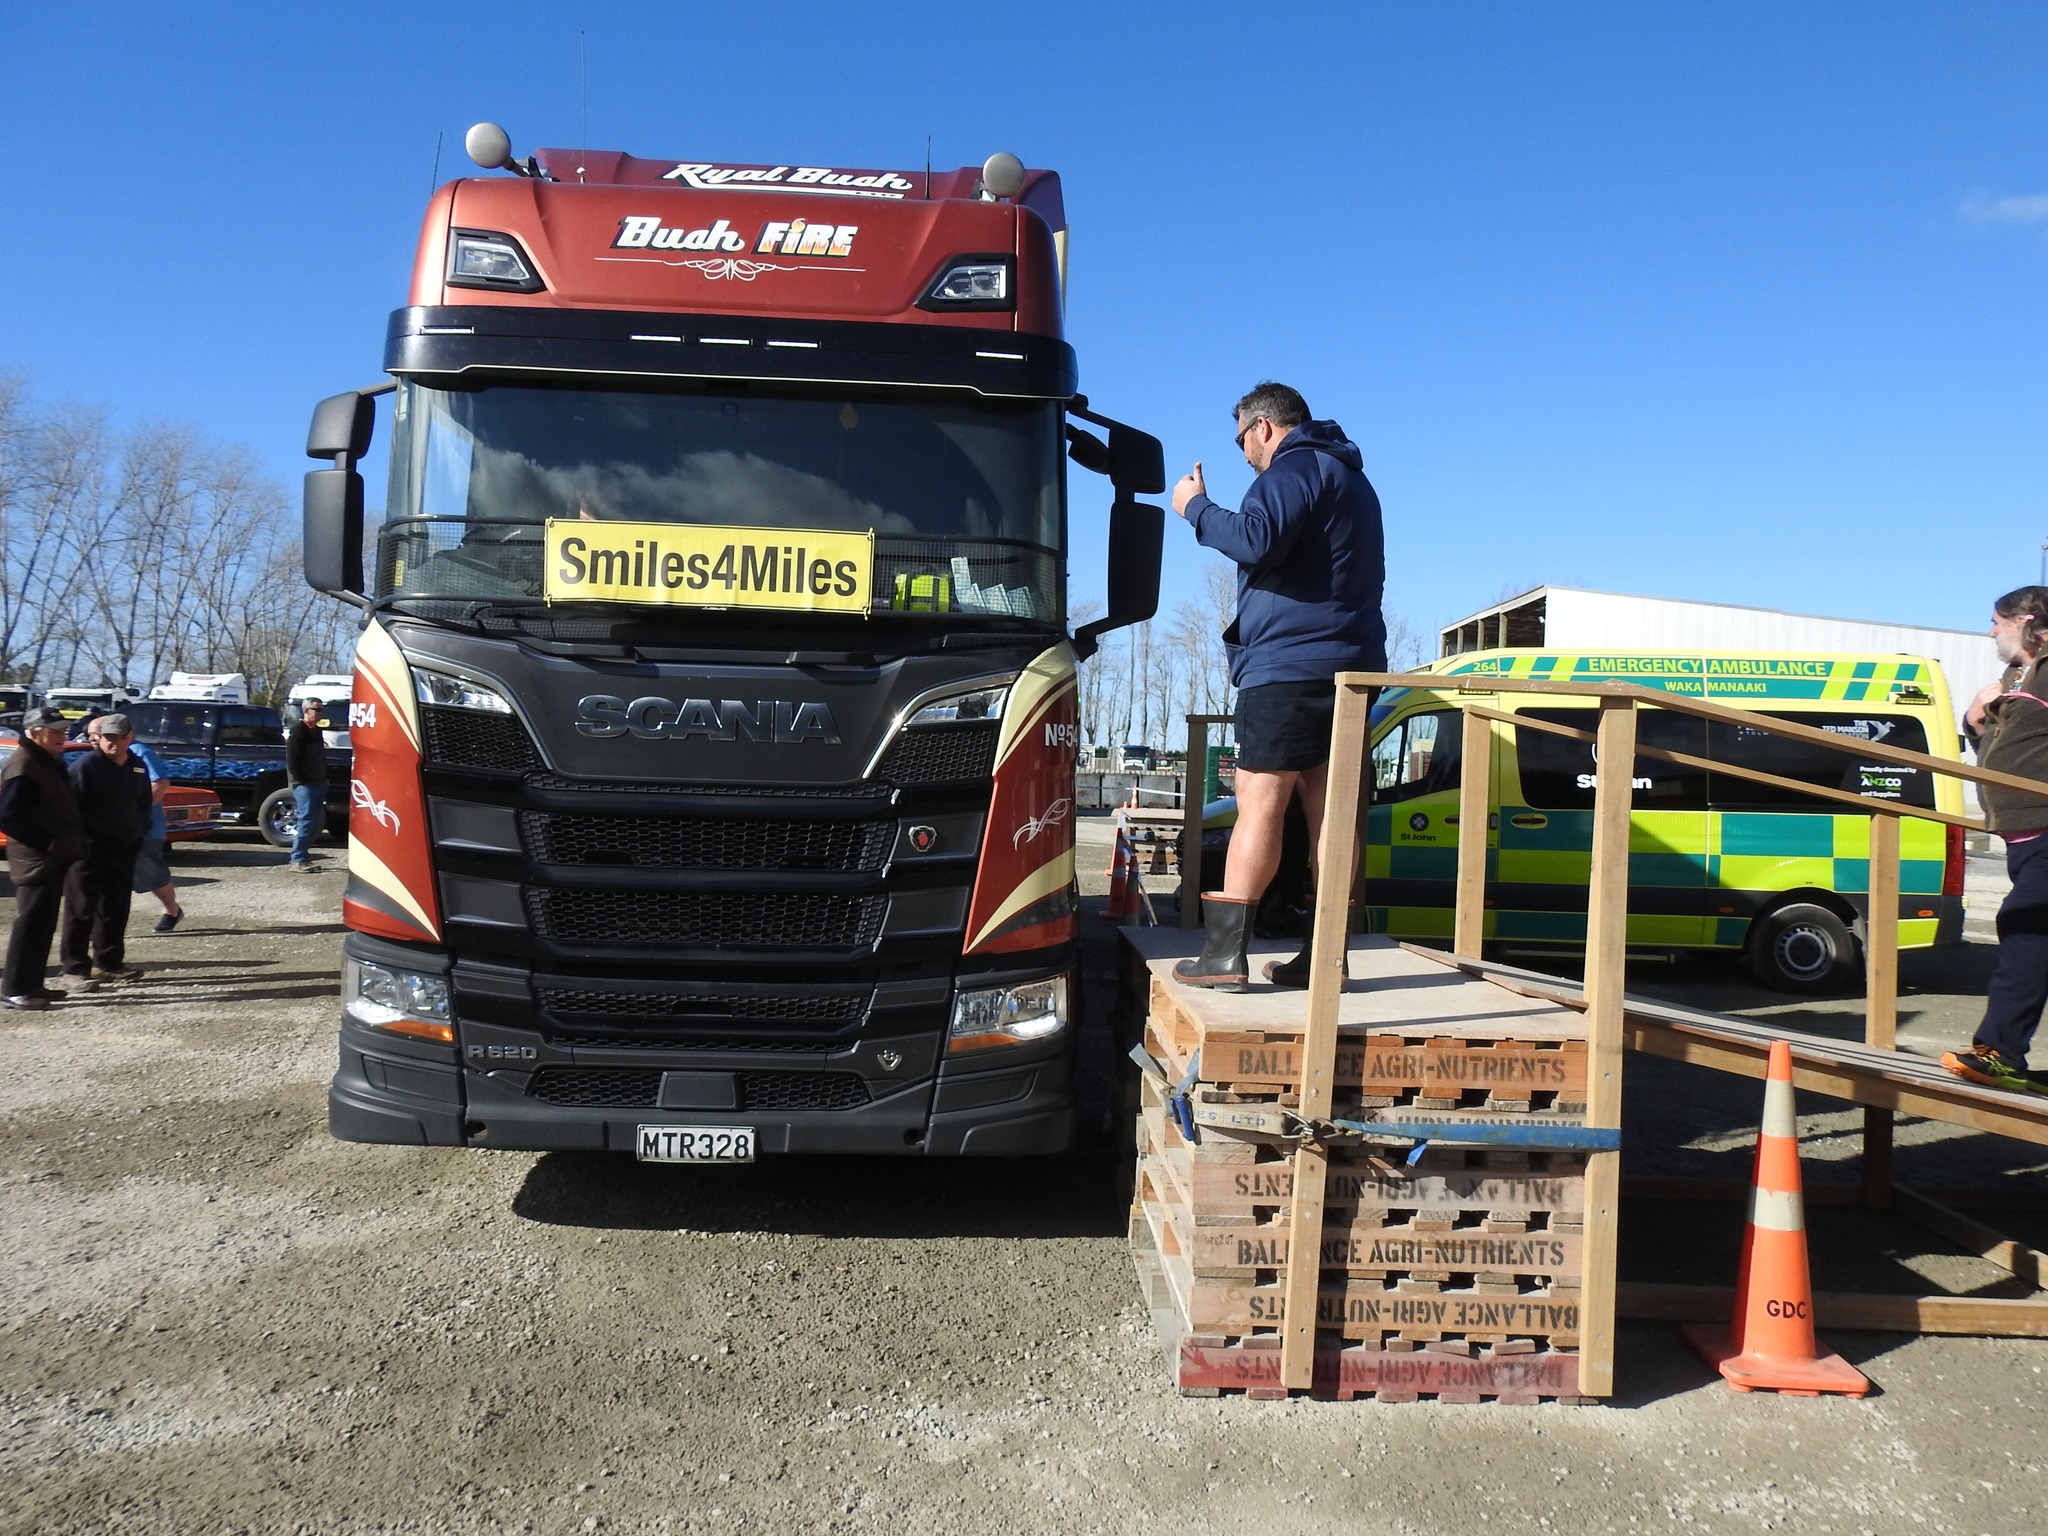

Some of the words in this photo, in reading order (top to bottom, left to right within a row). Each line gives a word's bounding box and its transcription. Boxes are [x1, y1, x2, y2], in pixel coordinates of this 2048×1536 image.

[662, 163, 789, 189] Ryal
[786, 167, 914, 191] Bush
[614, 215, 746, 252] Bush
[559, 537, 858, 597] Smiles4Miles
[1472, 662, 1497, 672] 264
[1588, 658, 1700, 673] EMERGENCY
[1709, 659, 1827, 676] AMBULANCE
[1664, 681, 1702, 692] WAKA
[1707, 681, 1767, 693] MANAAKI
[574, 694, 842, 745] SCANIA
[1860, 773, 1902, 787] ANZCO
[1400, 833, 1411, 841] St
[1412, 833, 1437, 841] John
[1237, 1049, 1363, 1078] BALLCE
[1370, 1054, 1566, 1083] AGRI-NUTRIENTS
[643, 1132, 750, 1160] MTR328
[1368, 1239, 1565, 1267] AGRI-NUTRIENTS
[1453, 1301, 1579, 1329] BALLANCE
[1766, 1299, 1806, 1319] GDC
